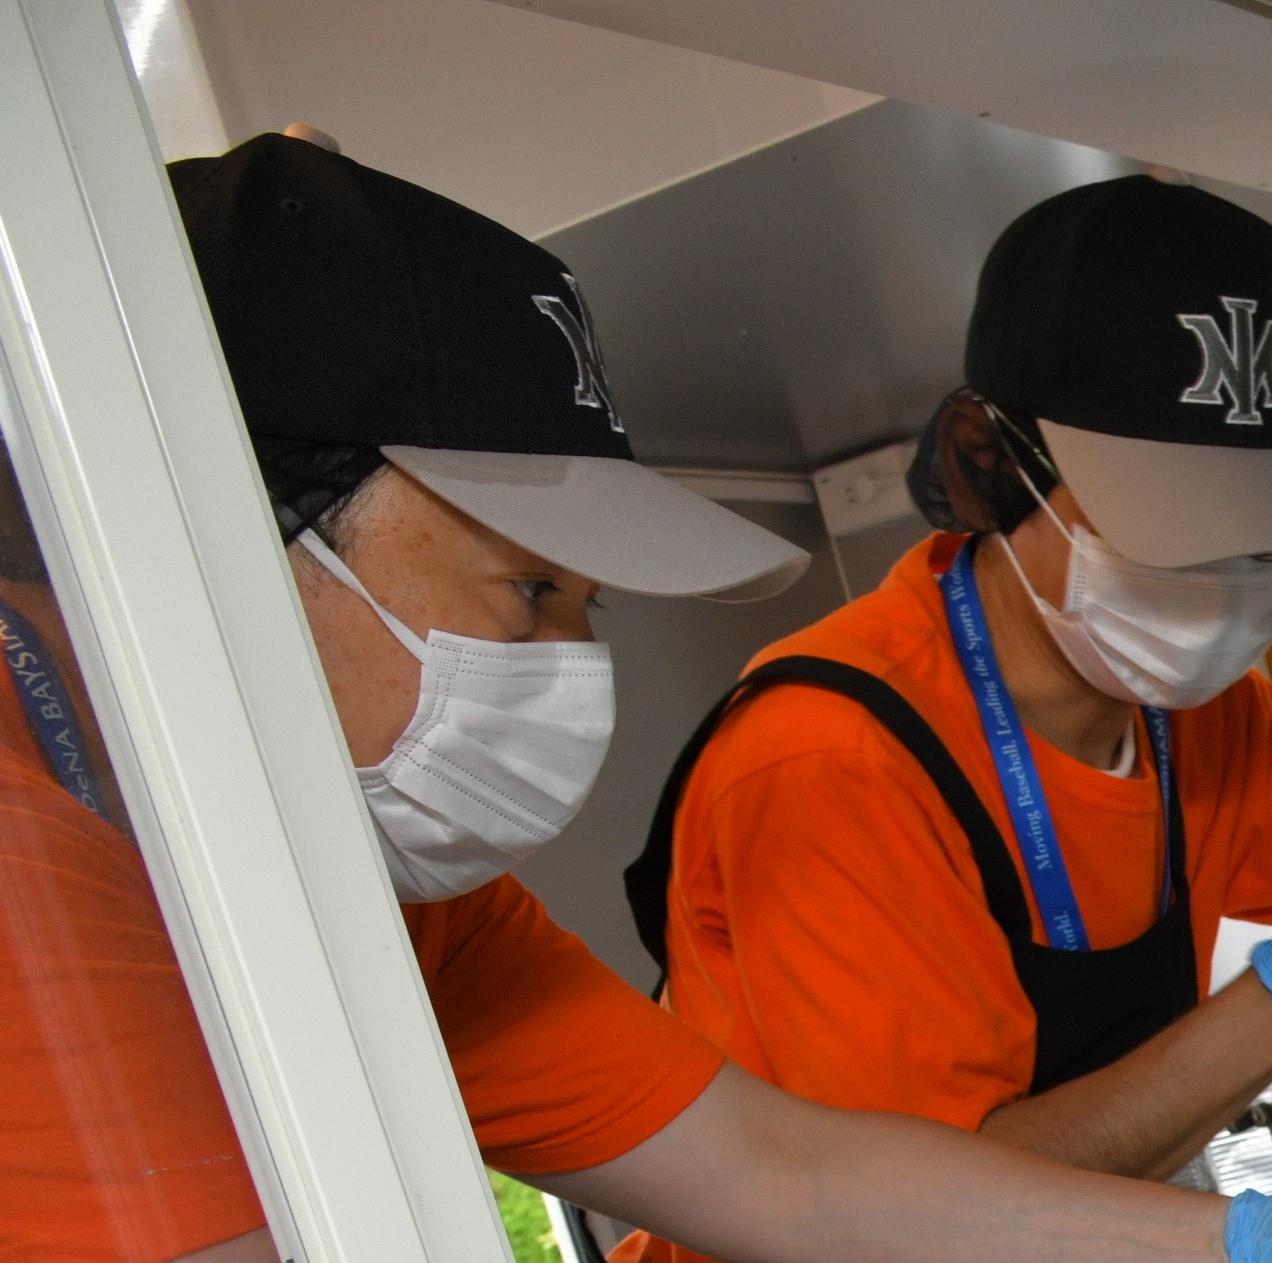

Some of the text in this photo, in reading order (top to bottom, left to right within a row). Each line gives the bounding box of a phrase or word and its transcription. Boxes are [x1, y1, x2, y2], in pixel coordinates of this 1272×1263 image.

[959, 603, 982, 652] Sports
[972, 655, 991, 678] the
[984, 680, 1013, 735] Leading
[1001, 739, 1035, 808] Baseball.
[1026, 809, 1054, 871] Moving
